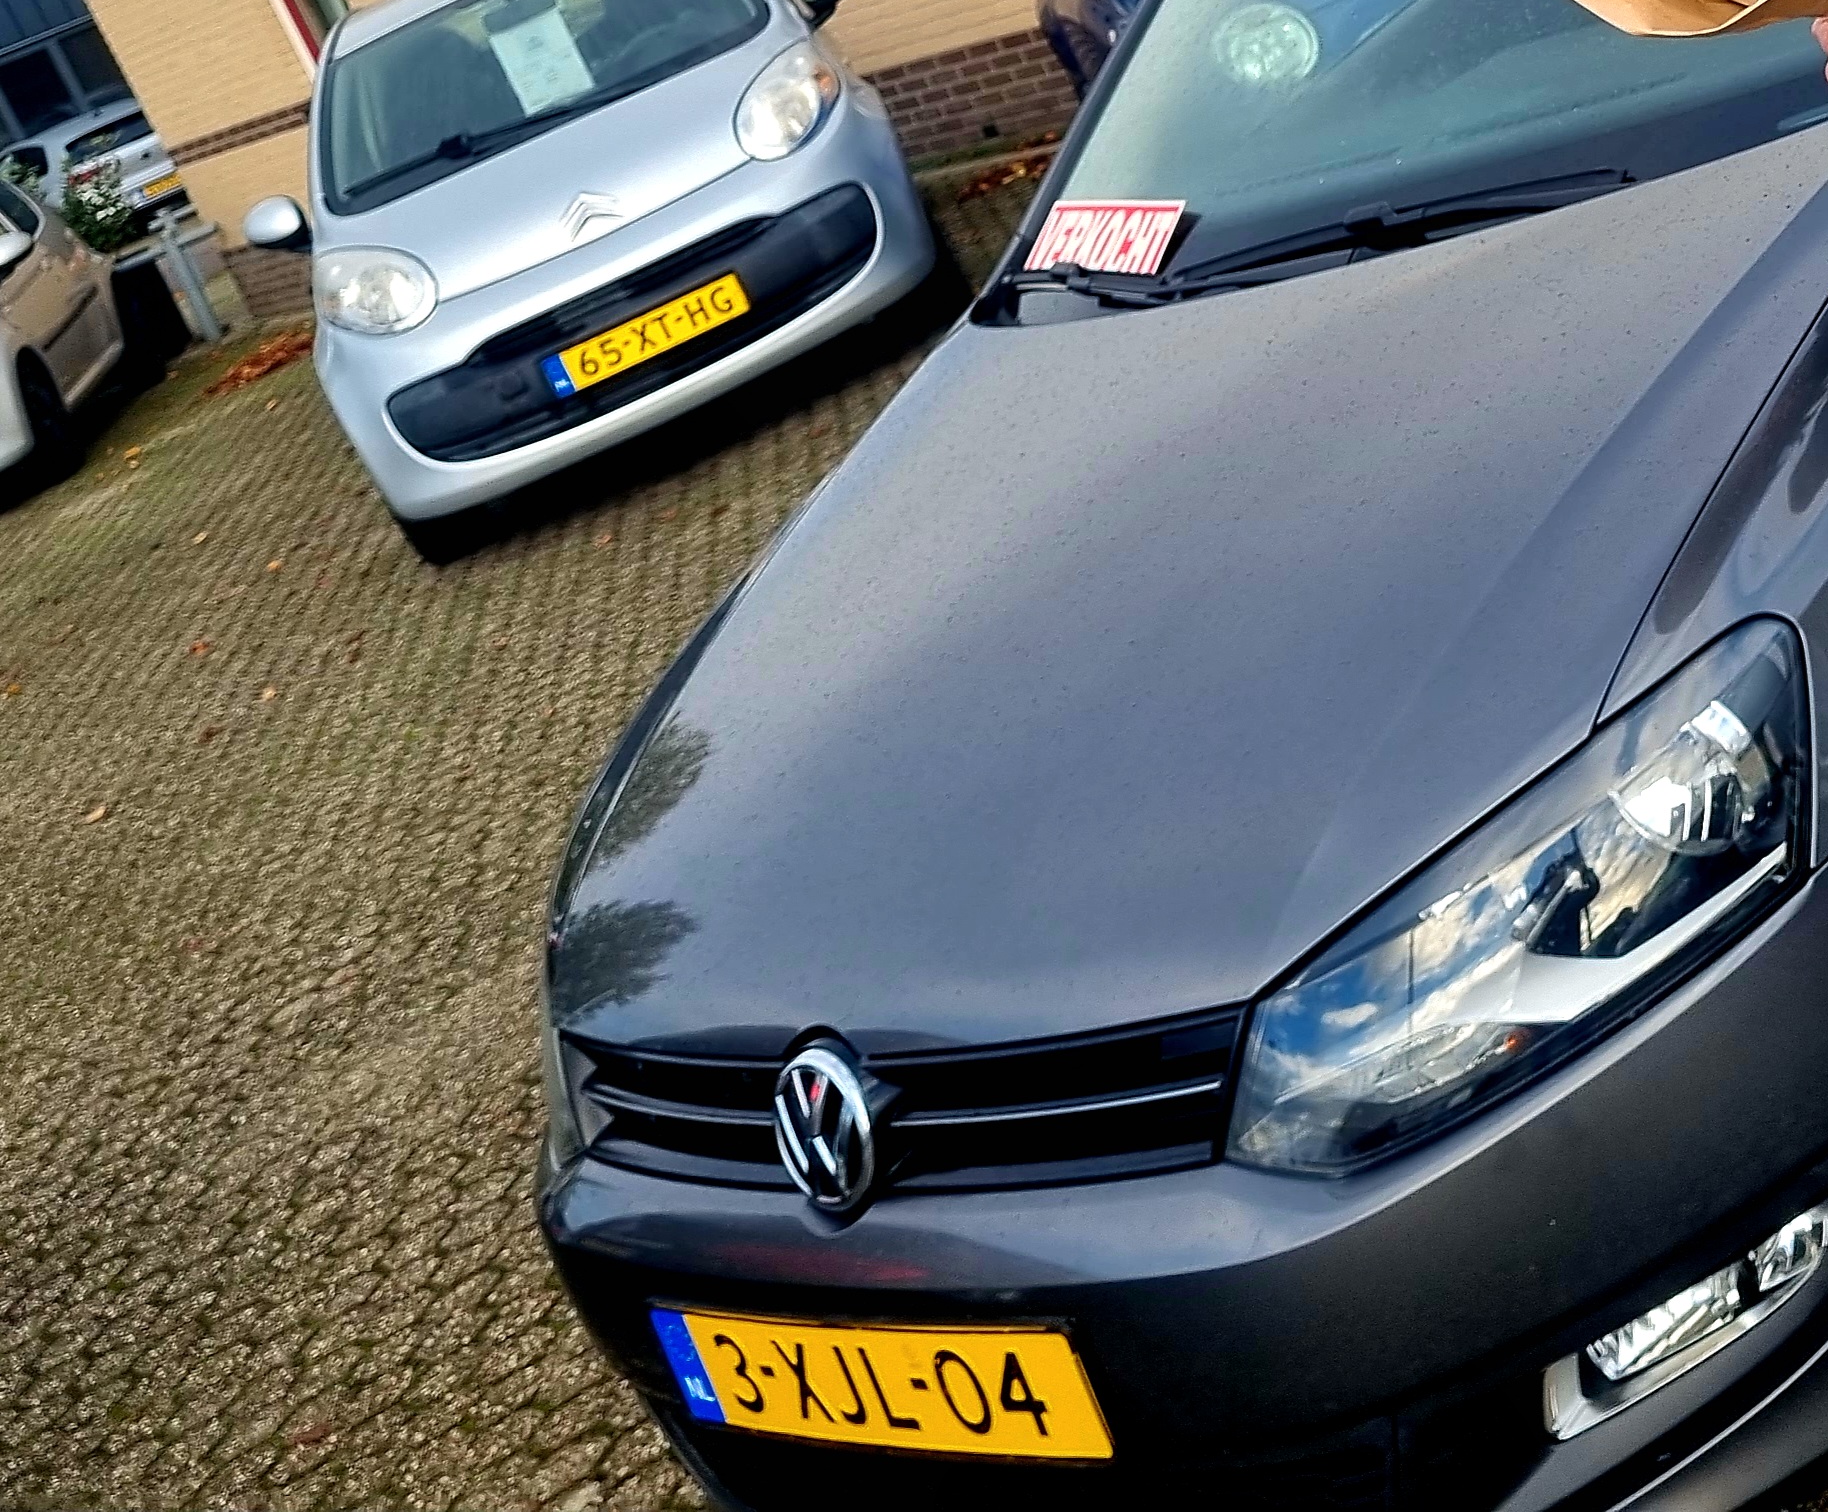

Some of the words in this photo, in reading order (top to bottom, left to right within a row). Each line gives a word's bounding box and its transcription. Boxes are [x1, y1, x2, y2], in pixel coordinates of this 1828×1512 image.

[579, 286, 734, 376] 65-XT-HG
[685, 1375, 716, 1402] NL
[713, 1334, 1049, 1436] 3-XJL-04
